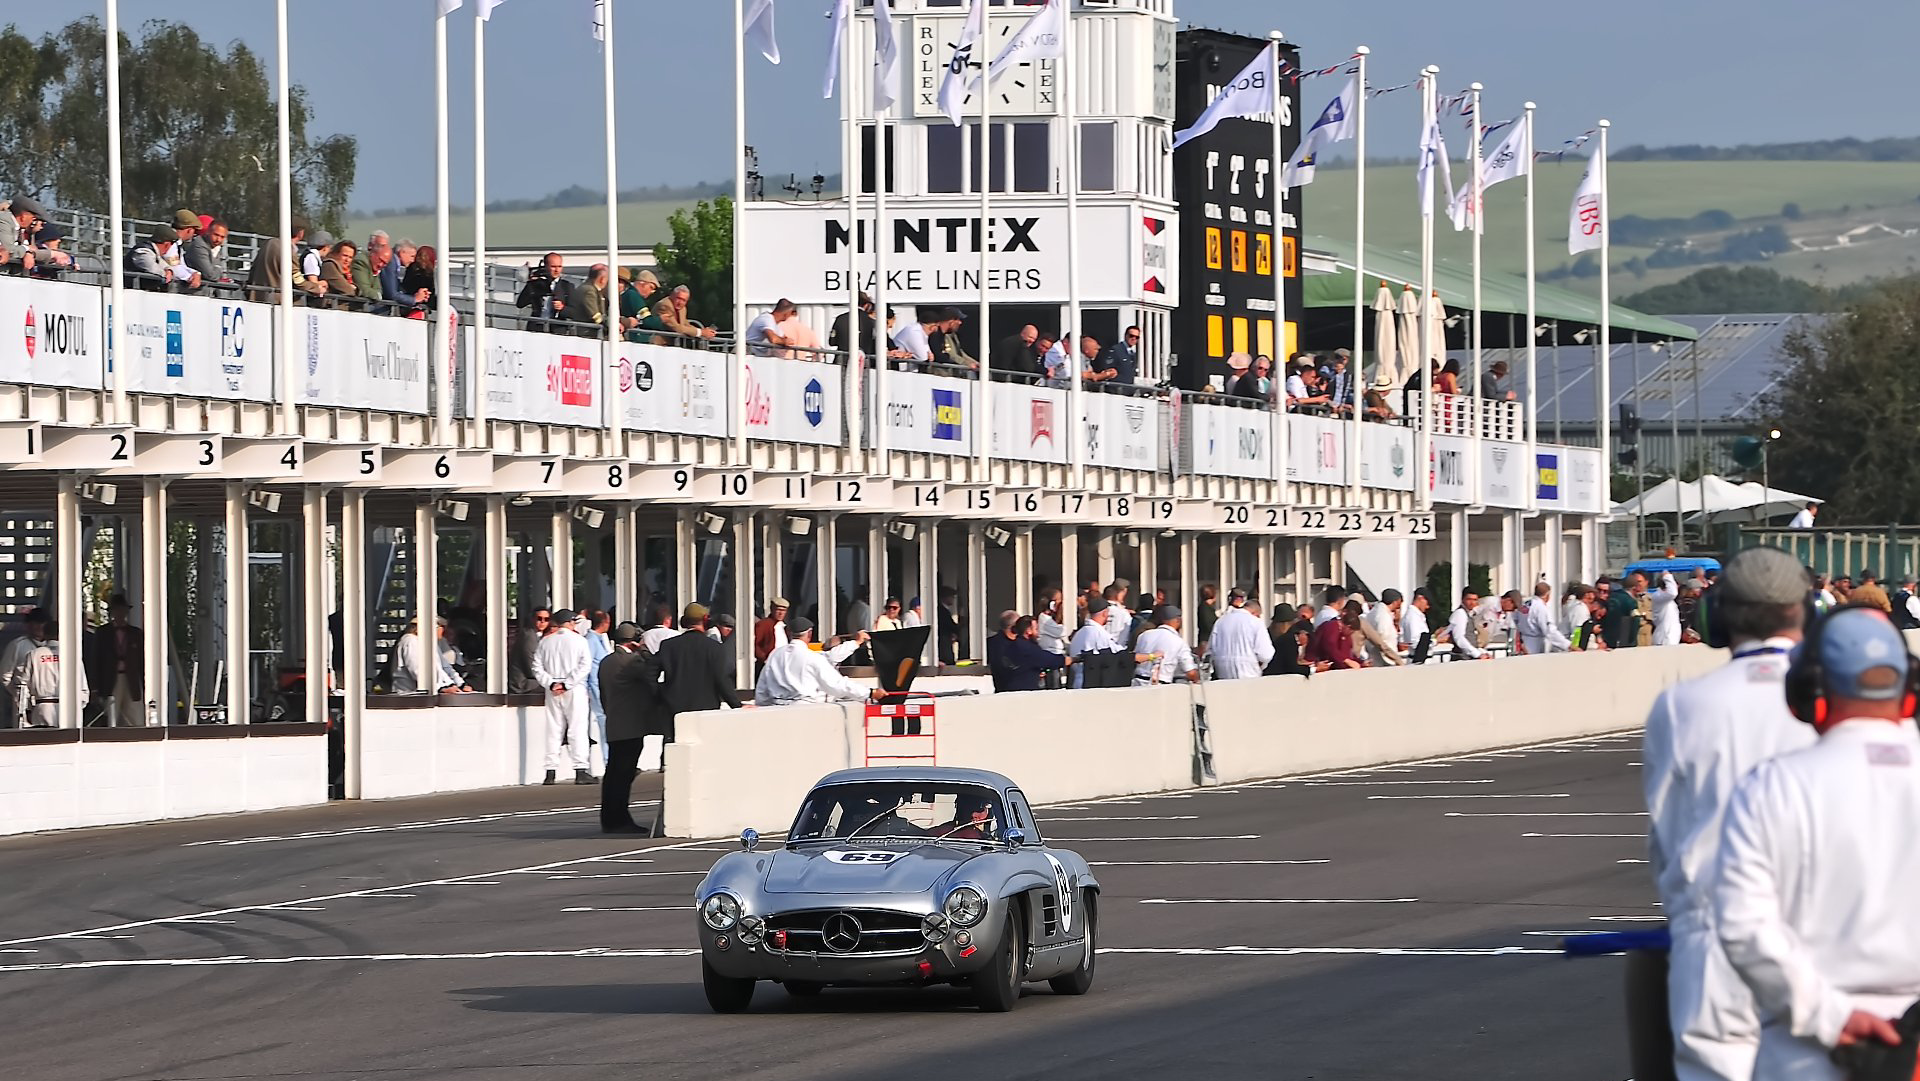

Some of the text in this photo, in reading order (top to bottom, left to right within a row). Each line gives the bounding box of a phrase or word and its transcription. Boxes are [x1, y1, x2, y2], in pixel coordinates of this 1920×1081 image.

[921, 27, 934, 105] ROLEX
[1040, 59, 1053, 103] LEX
[1577, 194, 1602, 236] UBS
[825, 217, 1040, 254] MNTEX
[936, 268, 1041, 290] LINERS
[44, 313, 88, 356] MOTUL
[28, 429, 33, 454] 1
[112, 435, 127, 460] 2
[200, 441, 213, 465] 3
[281, 446, 297, 469] 4
[361, 451, 374, 474] 5
[436, 456, 449, 478] 6
[541, 462, 555, 483] 7
[609, 465, 622, 487] 8
[675, 470, 687, 491] 9
[722, 475, 746, 495] 10
[787, 478, 804, 498] 11
[838, 482, 860, 501] 12
[914, 487, 938, 506] 14
[968, 490, 989, 508] 15
[1015, 494, 1037, 511] 16
[1061, 495, 1083, 513] 17
[1107, 498, 1128, 516] 18
[1151, 501, 1172, 518] 19
[1224, 506, 1249, 523] 20
[1267, 509, 1287, 526] 21
[1302, 512, 1324, 528] 22
[1339, 514, 1361, 530] 23
[1372, 516, 1394, 532] 24
[1409, 518, 1430, 533] 25
[840, 852, 896, 862] 69
